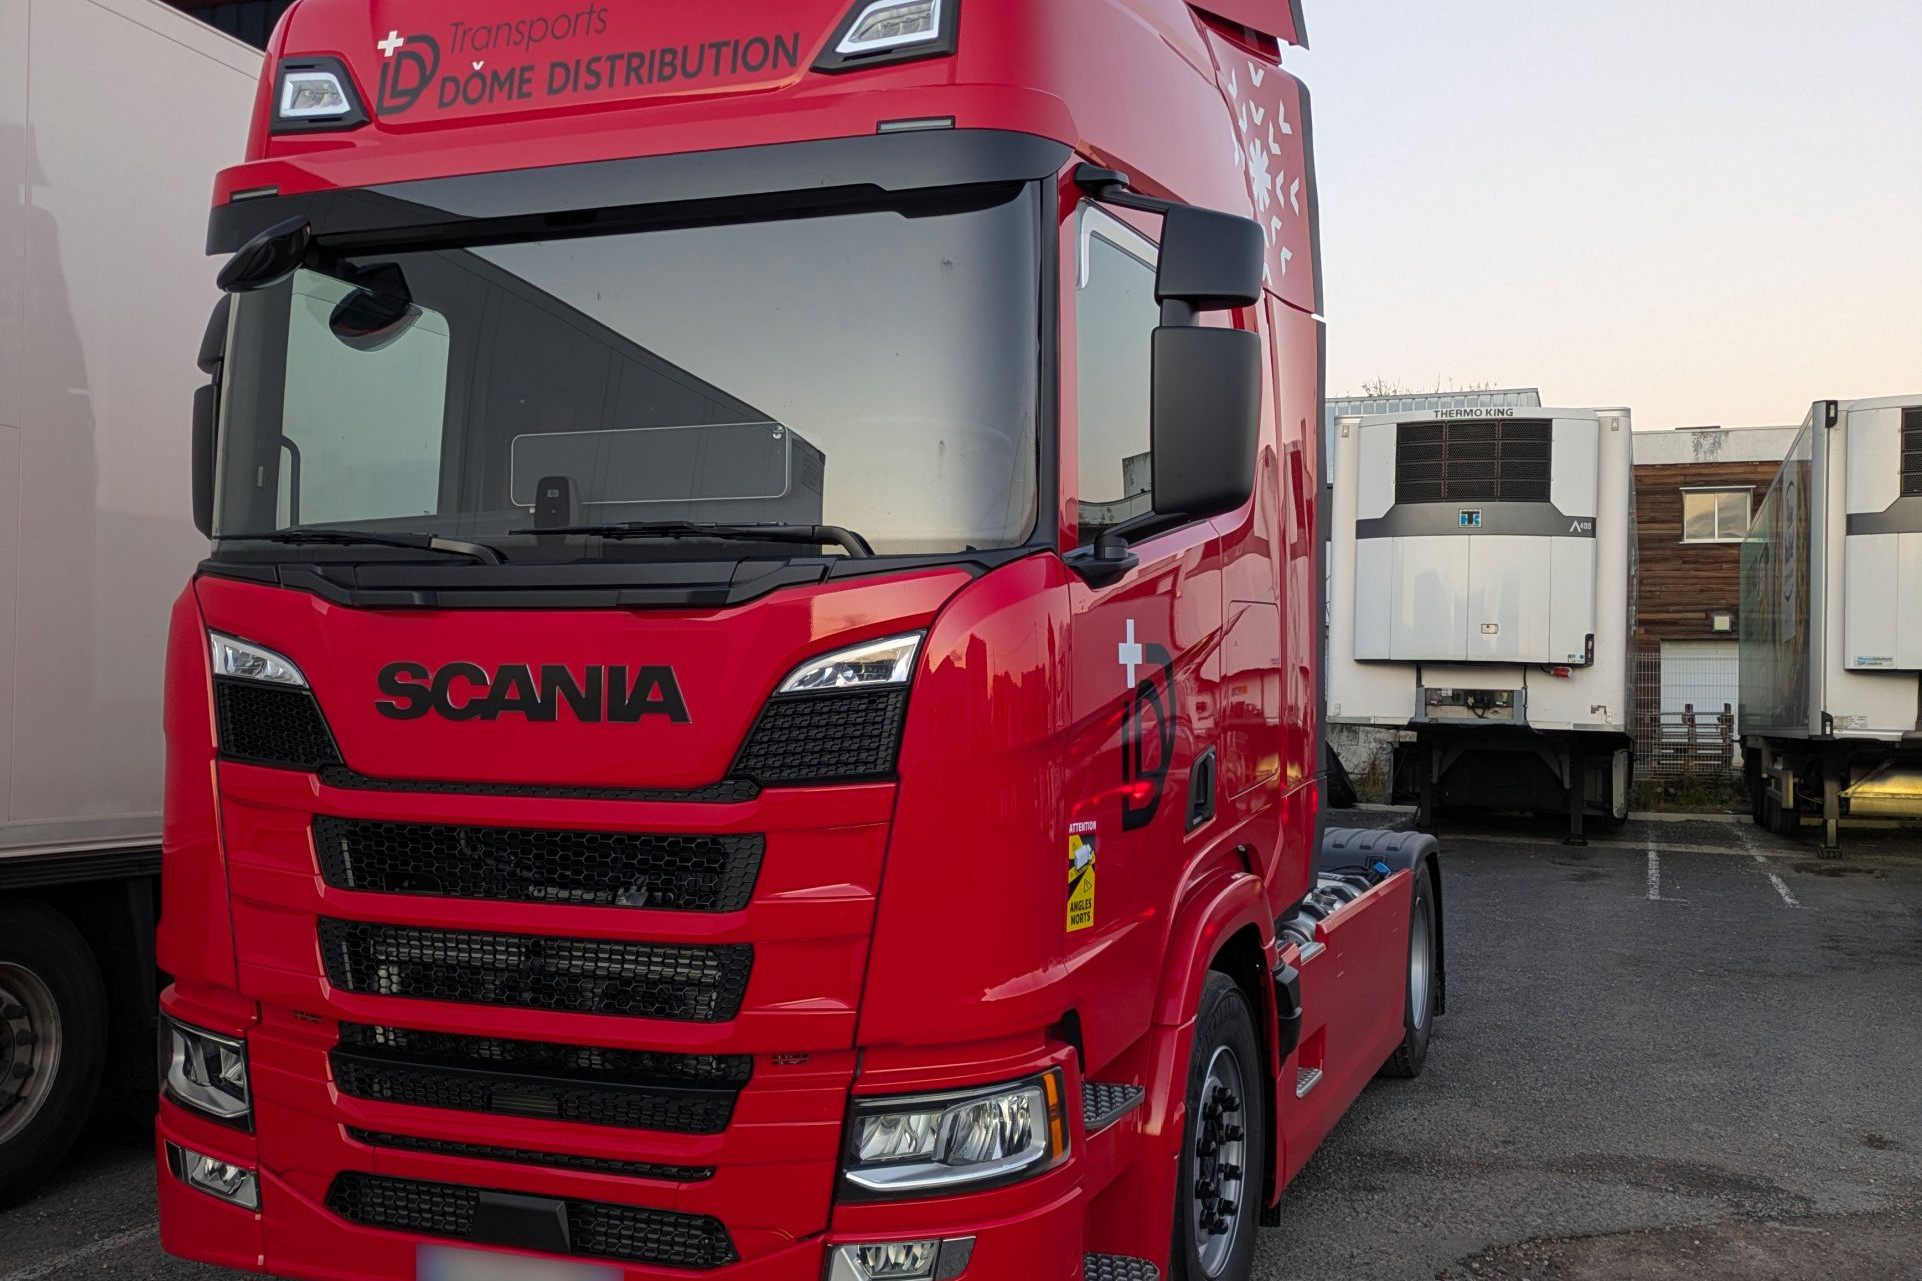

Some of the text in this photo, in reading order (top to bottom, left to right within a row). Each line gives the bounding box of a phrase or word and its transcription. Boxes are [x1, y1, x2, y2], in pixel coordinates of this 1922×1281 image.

[451, 3, 608, 54] Transports
[547, 32, 799, 96] DISTRIBUTION
[1434, 408, 1514, 419] THERMO KING
[374, 660, 693, 724] SCANIA
[1068, 820, 1097, 834] ATTENTION
[1070, 898, 1092, 914] ANGLES
[1070, 911, 1091, 926] MORTS
